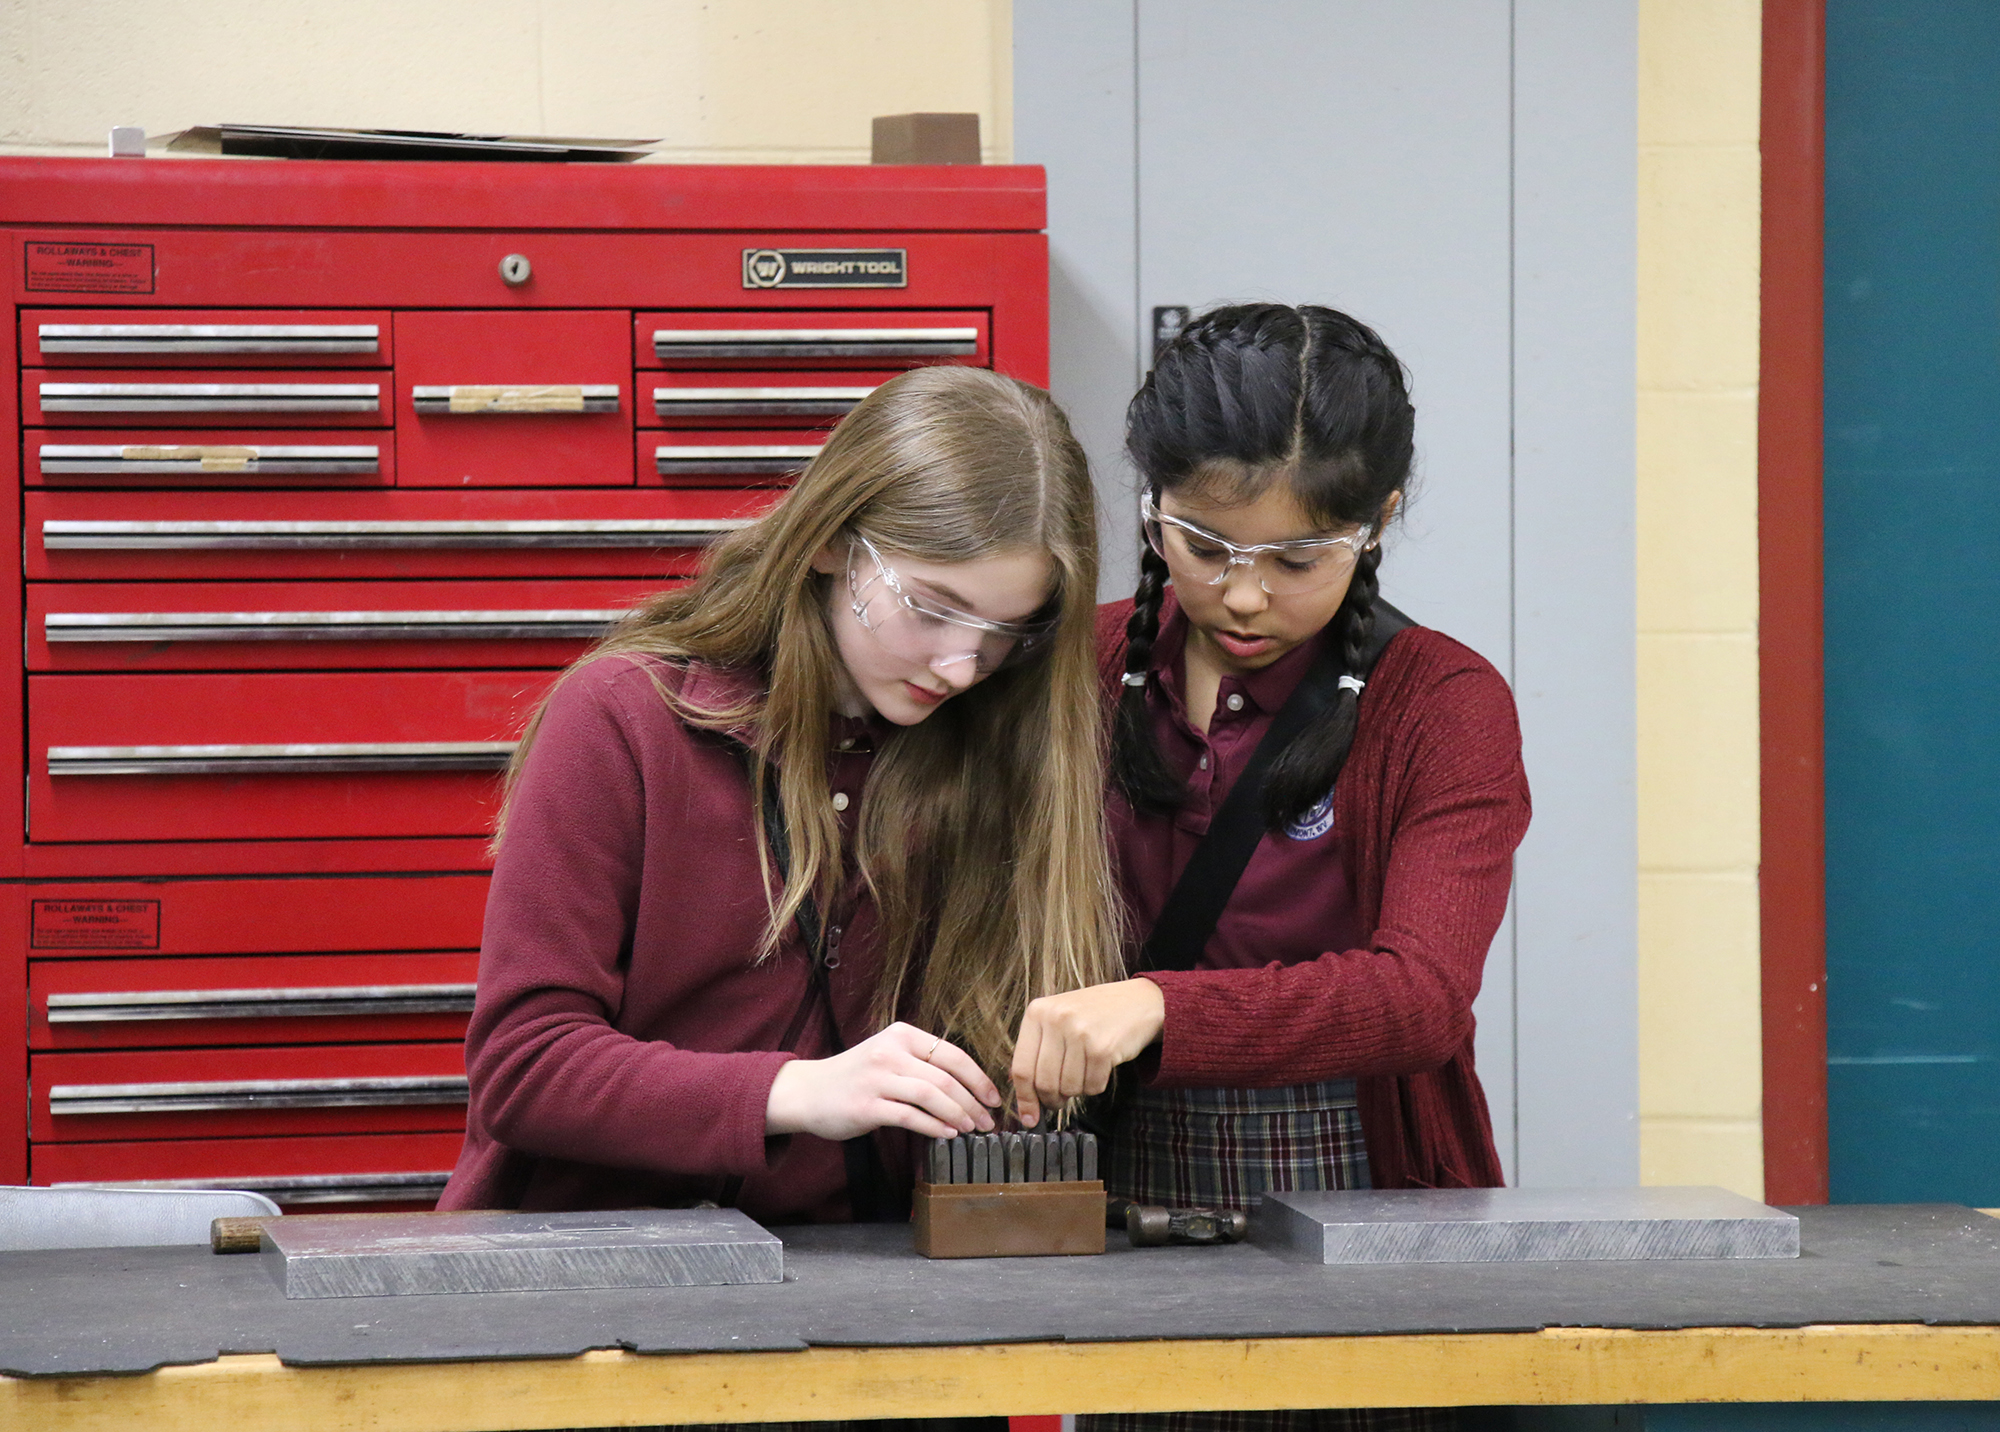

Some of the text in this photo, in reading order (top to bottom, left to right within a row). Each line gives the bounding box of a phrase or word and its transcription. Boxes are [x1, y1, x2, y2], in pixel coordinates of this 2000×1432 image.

[37, 246, 143, 257] ROLLAWAYS & CHEST
[791, 262, 901, 274] WRIGHT TOOL
[44, 904, 149, 913] ROLLAWAYS & CHEST
